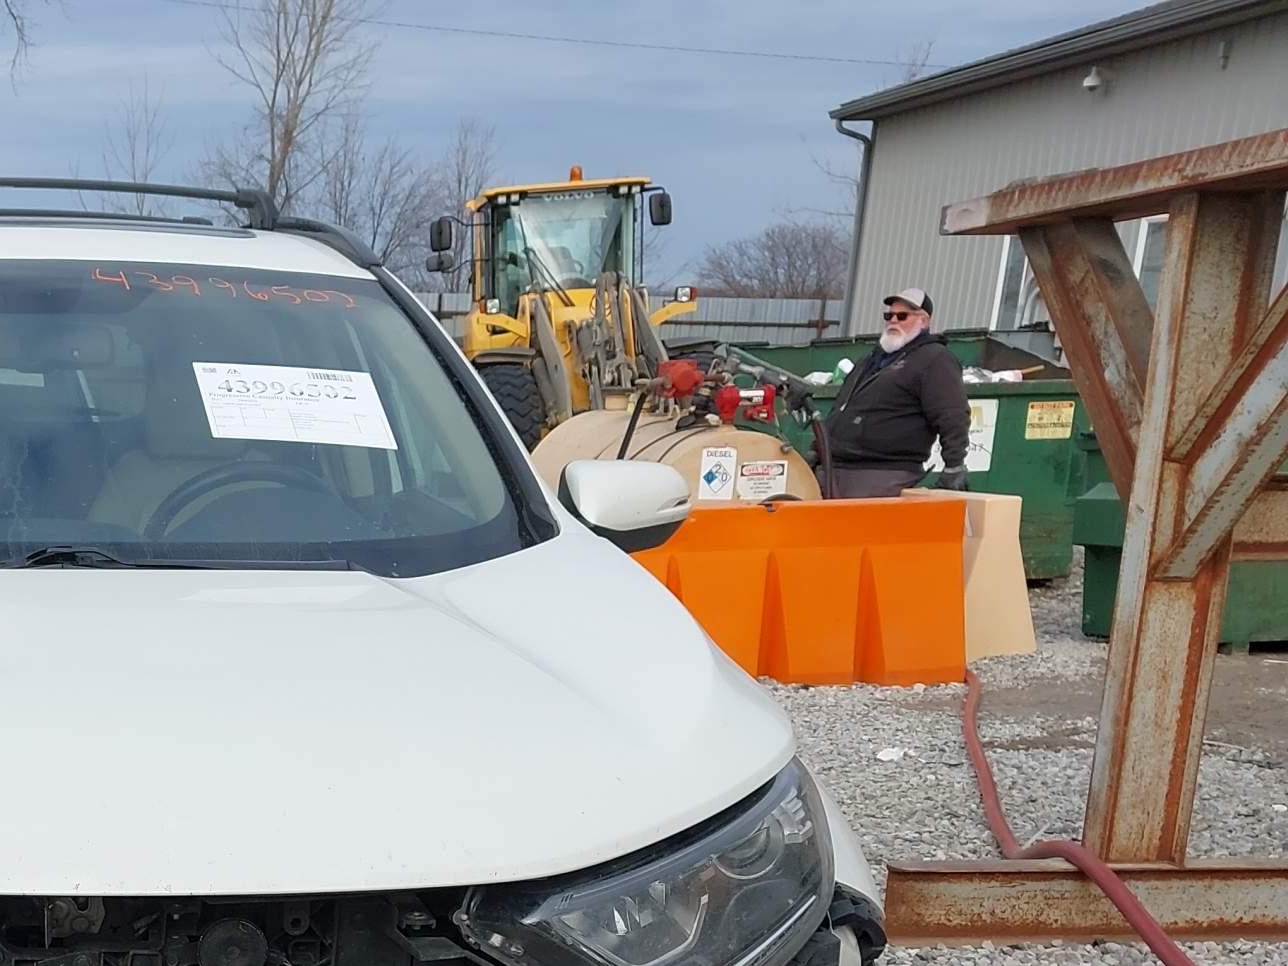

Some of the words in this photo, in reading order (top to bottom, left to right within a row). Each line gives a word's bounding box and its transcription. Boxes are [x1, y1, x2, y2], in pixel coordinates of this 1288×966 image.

[92, 268, 358, 308] 43996502
[217, 379, 358, 400] 43996502
[706, 450, 733, 458] DIESEL
